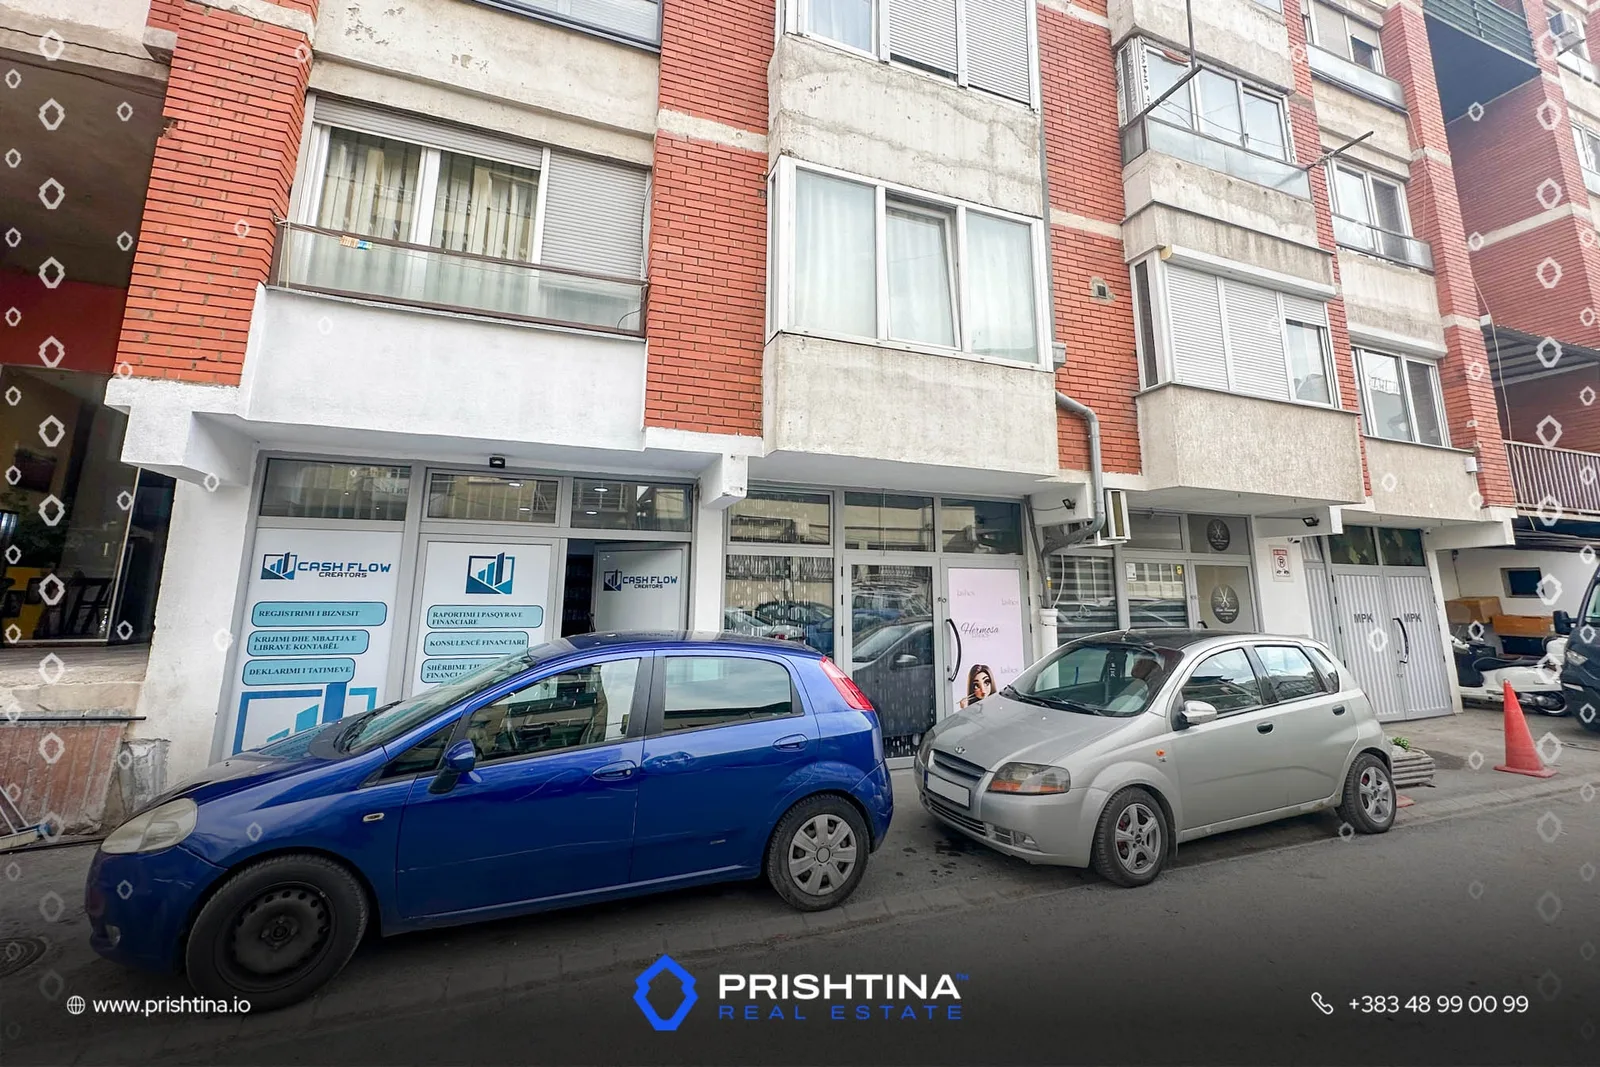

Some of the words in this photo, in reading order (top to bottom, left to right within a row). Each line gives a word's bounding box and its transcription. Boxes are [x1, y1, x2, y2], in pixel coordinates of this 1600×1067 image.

[297, 561, 343, 572] CASH
[347, 562, 392, 573] FLOW
[622, 576, 649, 584] CASH
[650, 576, 678, 584] FLOW
[1353, 613, 1374, 624] MPK
[1403, 613, 1422, 623] MPK
[960, 621, 999, 635] Hermosa
[293, 642, 340, 650] KONTABËL
[249, 667, 301, 676] DEKLARIMI
[307, 666, 352, 674] TATIMEVE
